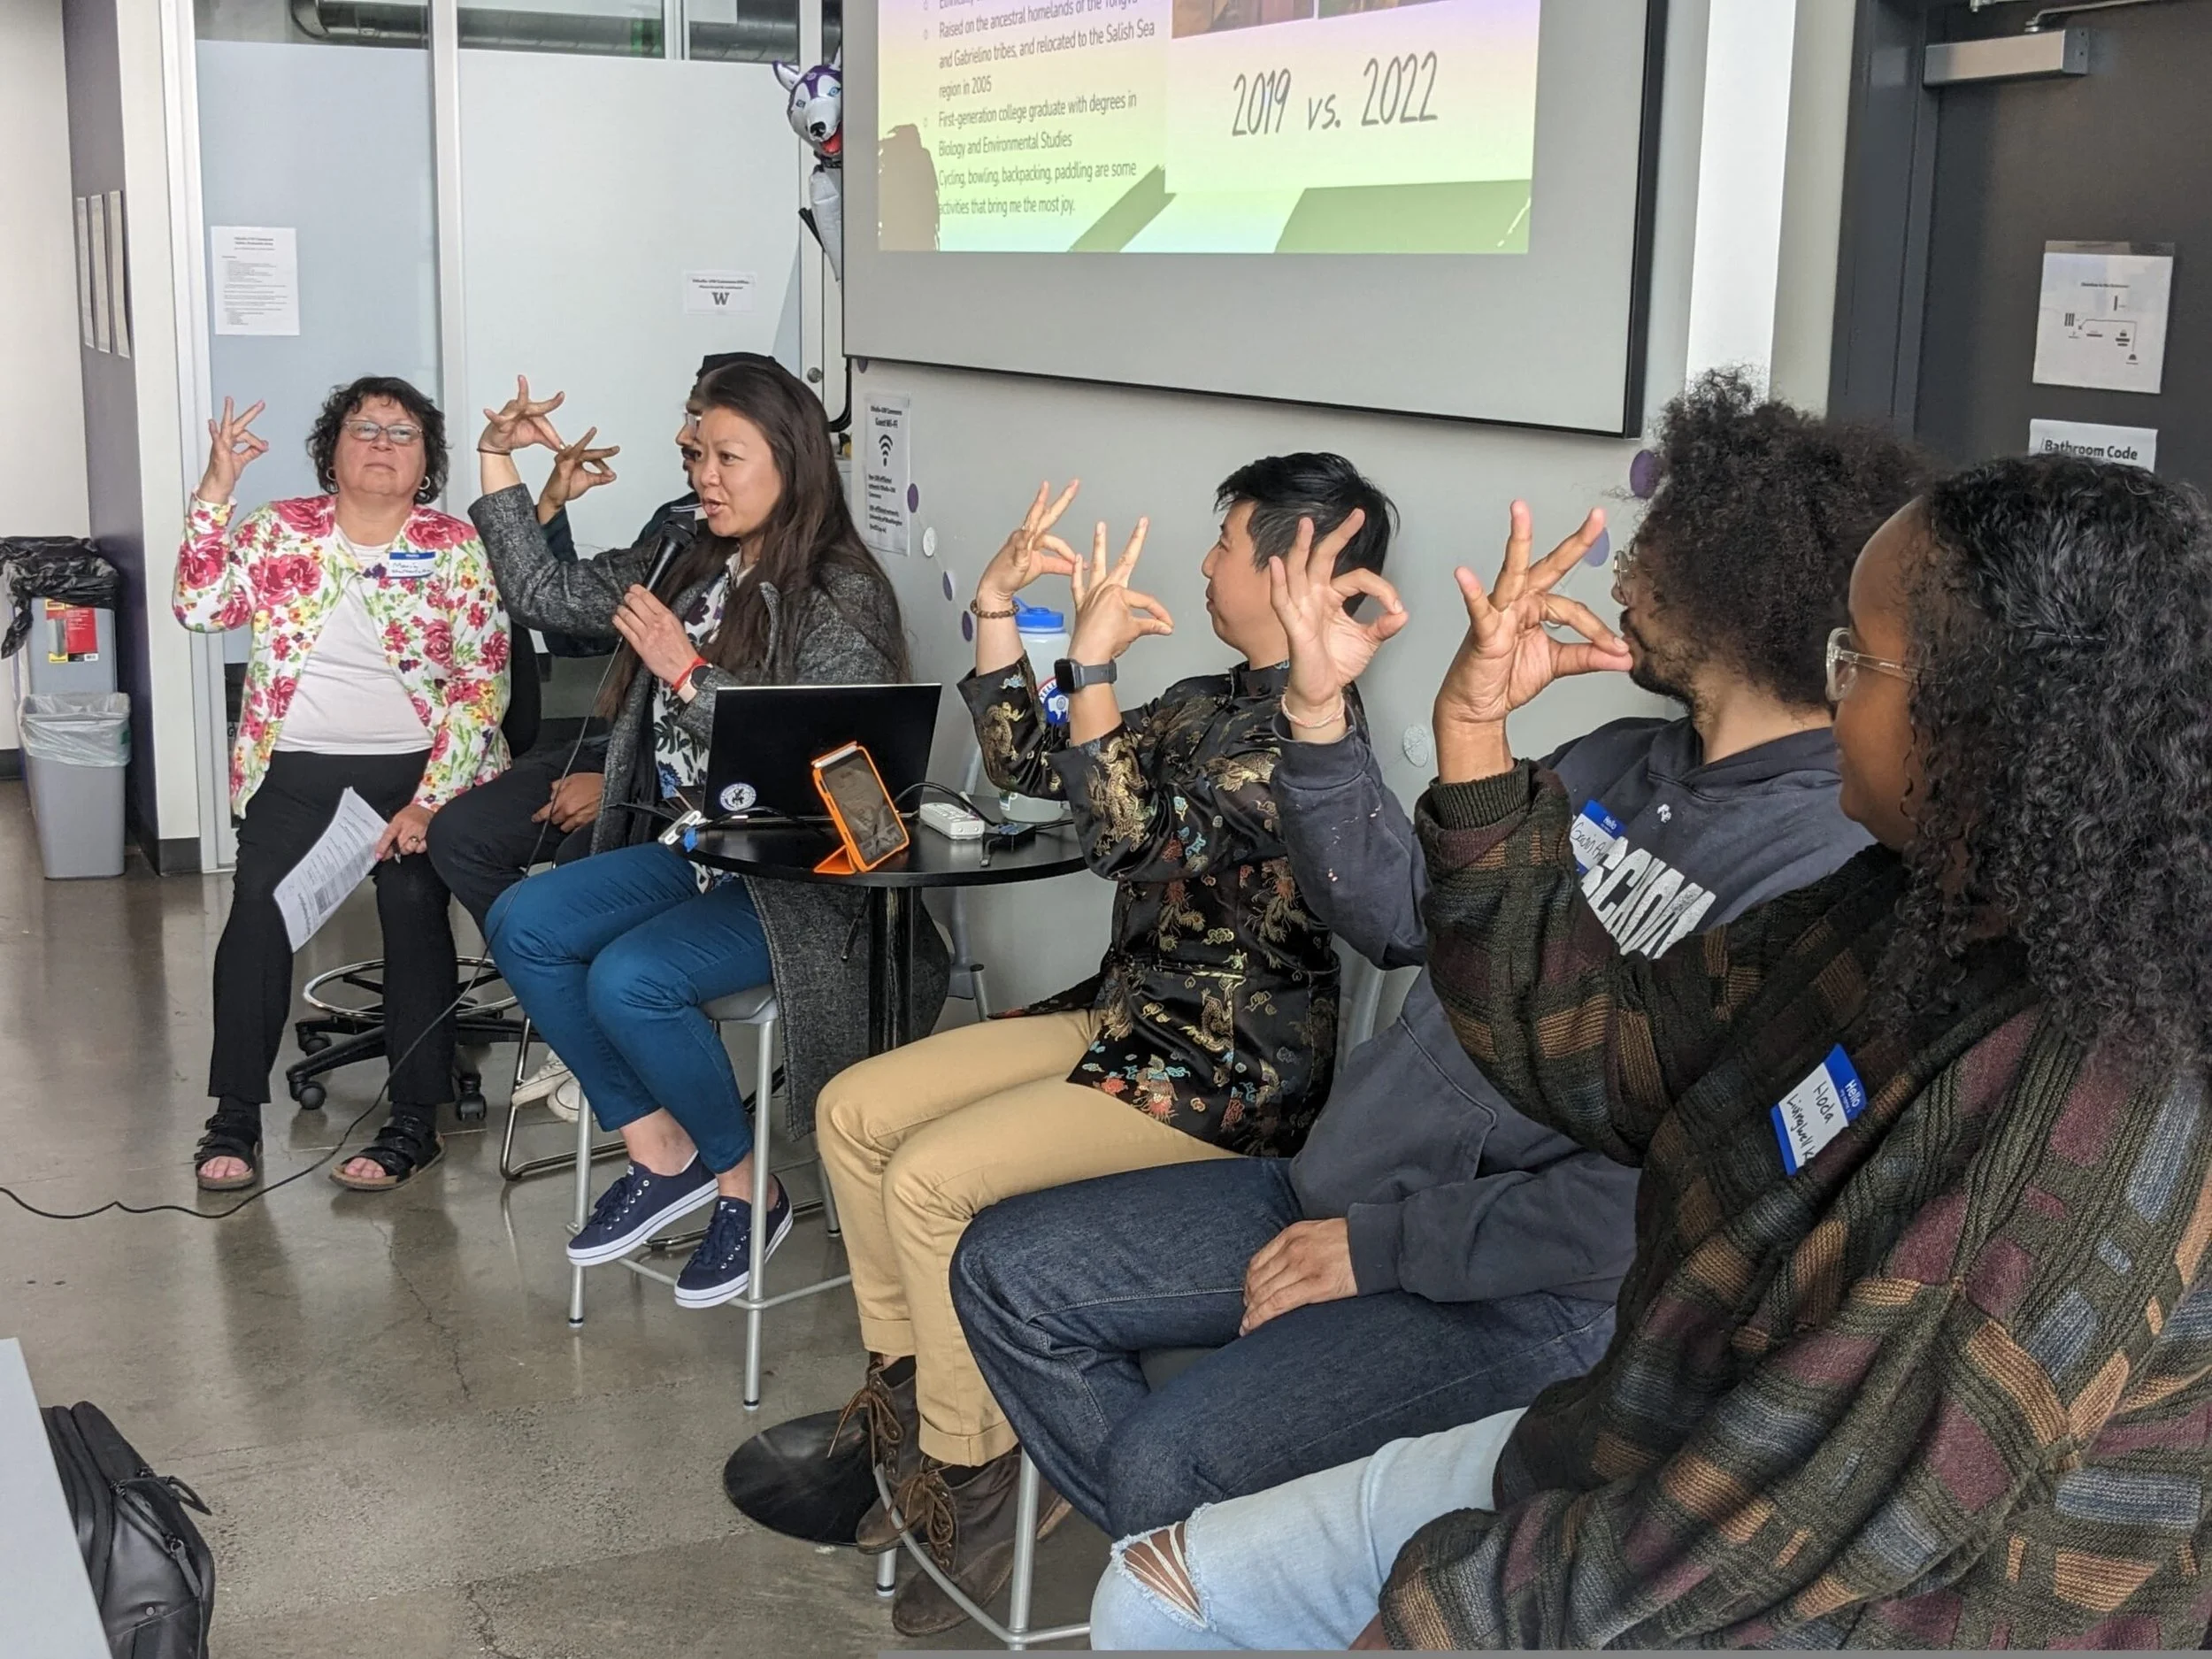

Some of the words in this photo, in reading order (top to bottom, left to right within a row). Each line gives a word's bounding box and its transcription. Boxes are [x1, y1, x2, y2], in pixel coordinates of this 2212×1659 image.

[939, 18, 964, 38] Raised
[964, 20, 975, 34] on
[976, 15, 989, 32] the
[990, 6, 1026, 29] ancestral
[1027, 0, 1073, 22] homelands
[1076, 0, 1084, 13] of
[939, 50, 953, 69] and
[955, 47, 992, 66] Gabrielino
[1019, 36, 1035, 56] and
[1036, 30, 1076, 53] relocated
[1078, 31, 1087, 47] to
[1089, 27, 1104, 45] the
[1106, 21, 1134, 42] Salish
[1137, 18, 1155, 38] Sea
[939, 81, 962, 101] region
[963, 78, 970, 96] in
[972, 74, 992, 94] 2005
[1232, 67, 1291, 136] 2019
[1308, 94, 1341, 130] vs.
[1361, 50, 1438, 127] 2022
[939, 107, 997, 129] First-generation
[999, 104, 1027, 124] college
[1029, 99, 1066, 122] graduate
[1068, 95, 1087, 113] with
[1089, 93, 1126, 115] degrees
[1128, 89, 1137, 107] in
[939, 140, 965, 158] Biology
[967, 138, 981, 154] and
[983, 133, 1039, 153] Environmental
[1041, 130, 1072, 150] Studies
[1055, 160, 1093, 183] paddling
[1094, 165, 1110, 178] are
[1111, 163, 1137, 177] some
[971, 197, 987, 214] that
[987, 196, 1008, 217] bring
[1009, 200, 1022, 213] me
[1023, 196, 1036, 213] the
[1038, 196, 1059, 213] most
[1060, 194, 1076, 216] joy.
[711, 292, 730, 305] W
[2044, 440, 2105, 457] Bathroom
[2107, 445, 2139, 460] Code
[1602, 815, 1617, 830] Hello
[1813, 1080, 1835, 1125] Hoda
[1845, 1079, 1861, 1108] Hello
